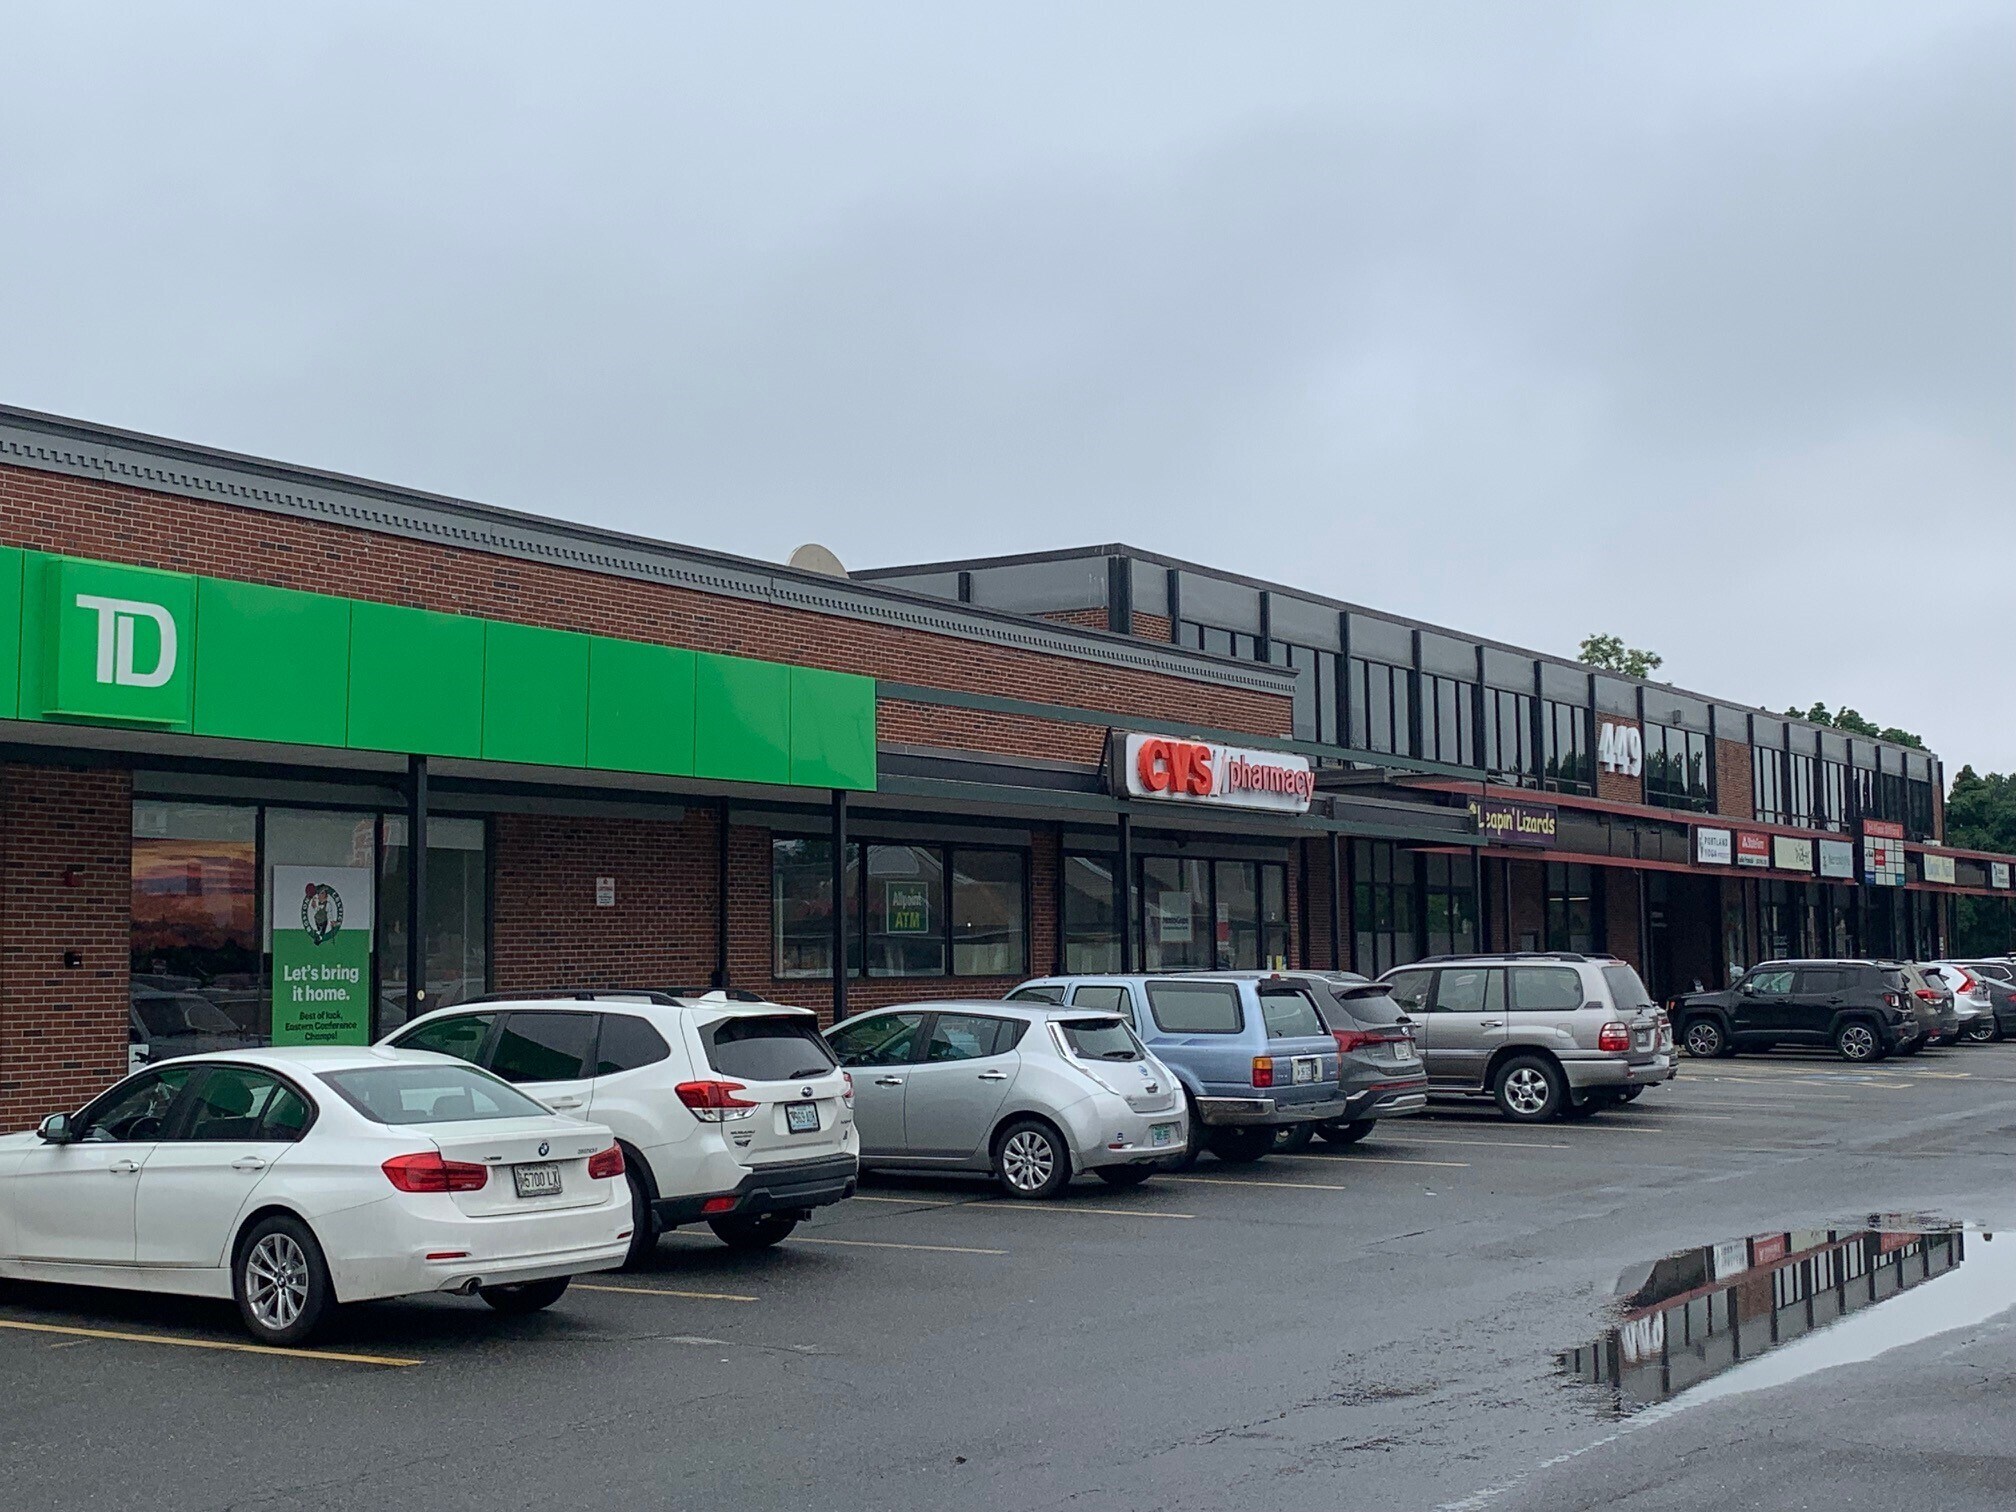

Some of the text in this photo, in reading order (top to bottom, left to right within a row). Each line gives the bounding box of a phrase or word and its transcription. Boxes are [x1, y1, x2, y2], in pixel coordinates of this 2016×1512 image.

[76, 593, 178, 688] TD
[1598, 722, 1643, 778] 449
[1138, 739, 1315, 802] CVS pharmacy
[1516, 809, 1555, 836] Lizards
[895, 911, 920, 928] ATM
[284, 964, 359, 983] Let's bring
[293, 985, 350, 1001] it home.
[300, 1011, 316, 1020] Best
[317, 1011, 325, 1019] of
[285, 1021, 357, 1031] Eastern Conference
[304, 1030, 338, 1041] Champs!
